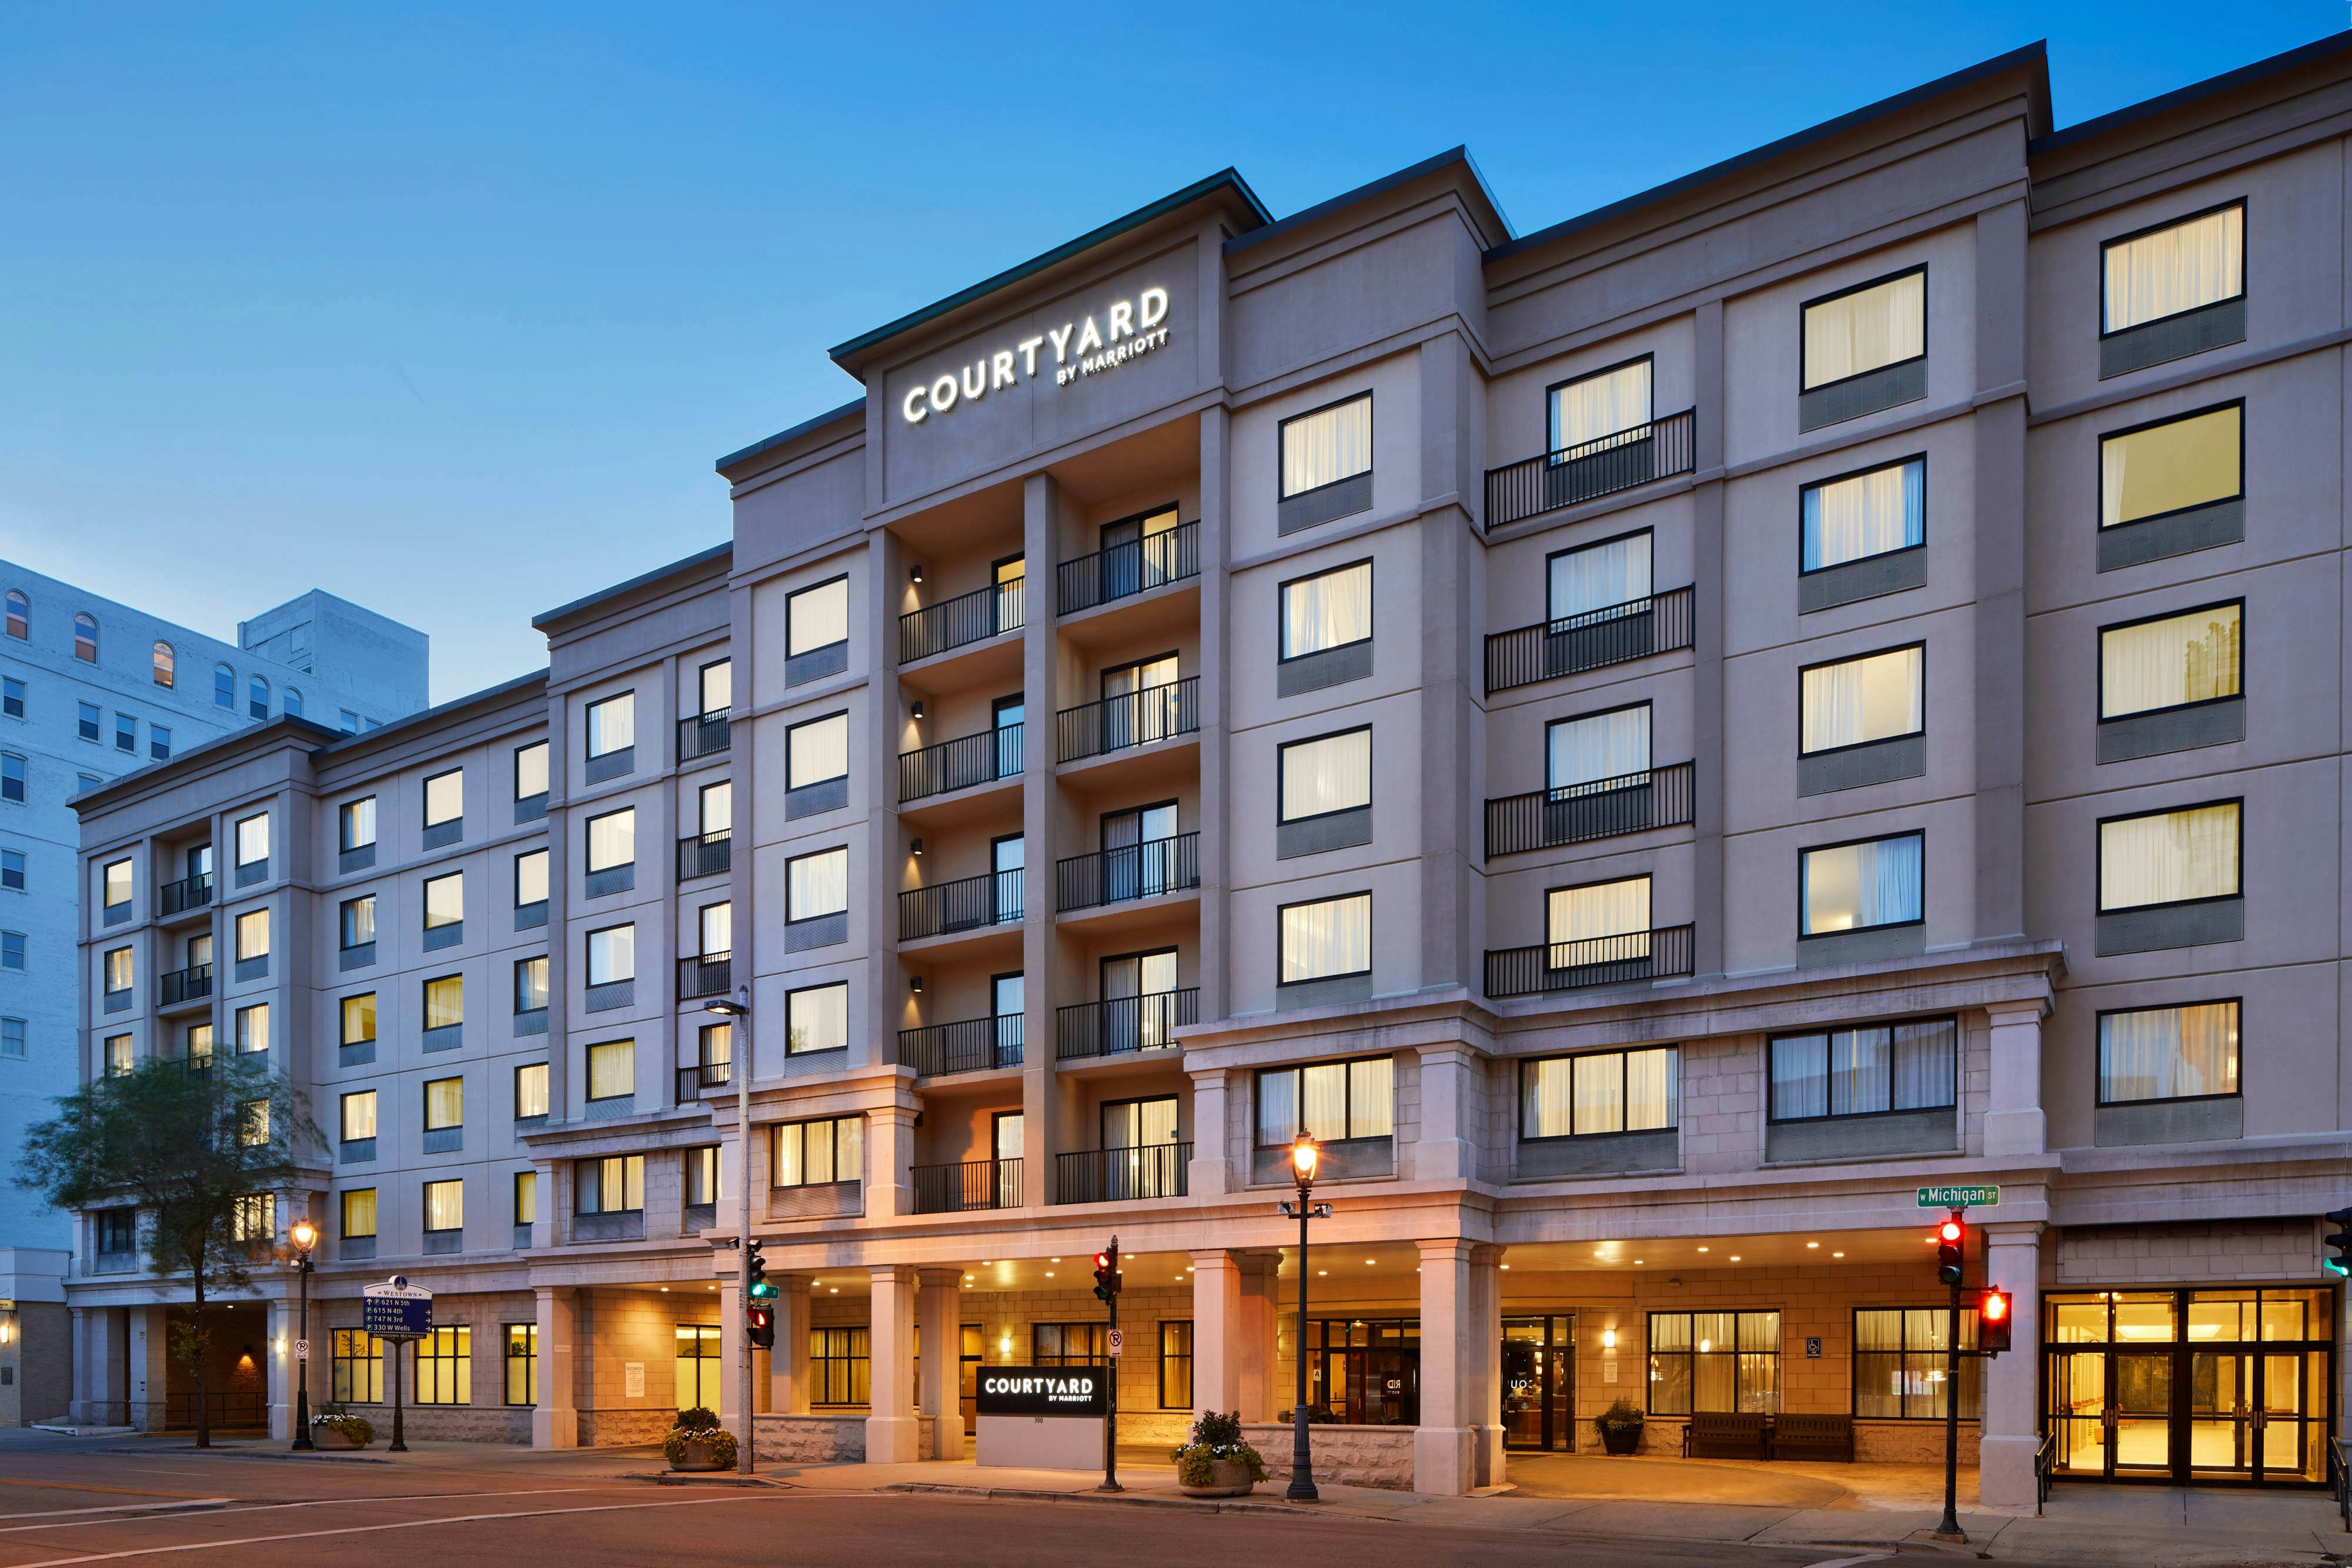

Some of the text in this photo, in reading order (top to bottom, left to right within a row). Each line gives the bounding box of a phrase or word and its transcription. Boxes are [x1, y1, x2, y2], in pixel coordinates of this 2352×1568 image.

[904, 288, 1170, 423] COURTYARD
[1057, 328, 1170, 386] BY MARRIOTT
[1929, 1188, 1984, 1205] Michigan
[985, 1378, 1093, 1394] COURTYARD
